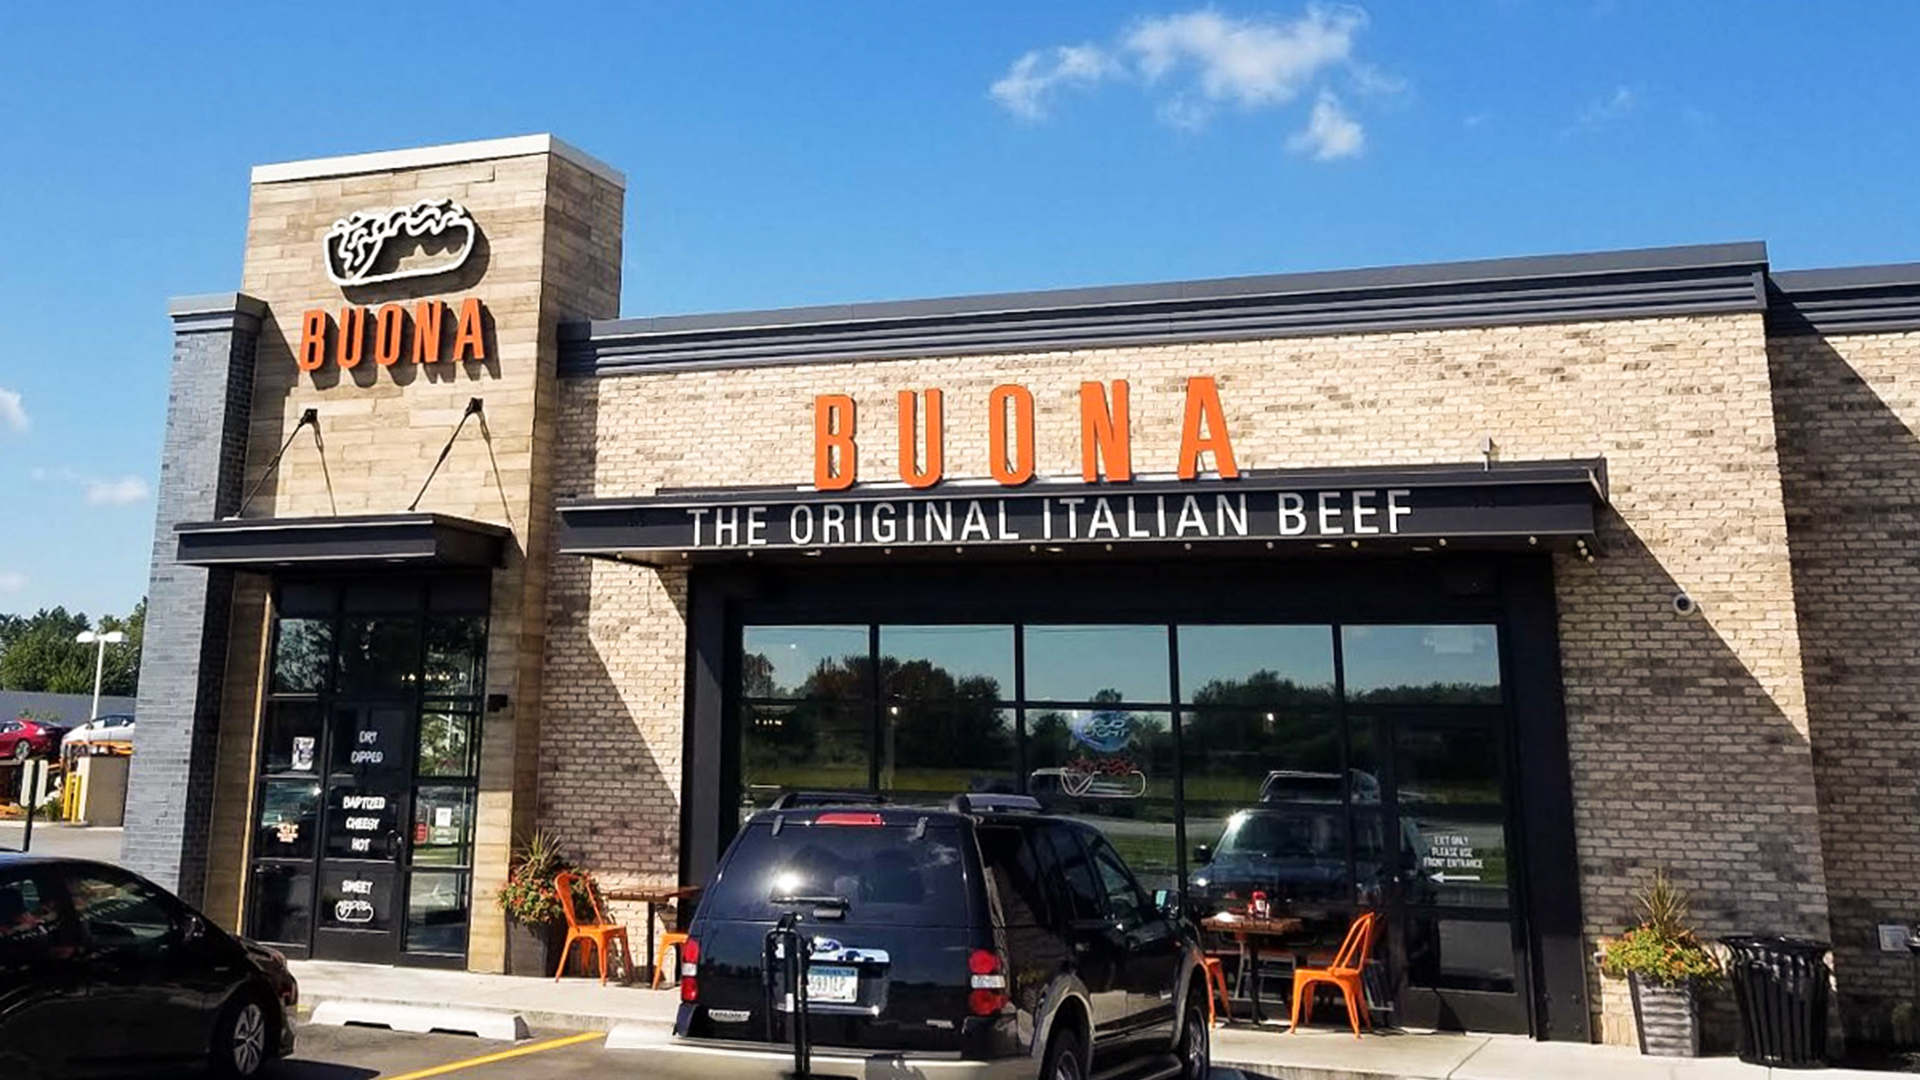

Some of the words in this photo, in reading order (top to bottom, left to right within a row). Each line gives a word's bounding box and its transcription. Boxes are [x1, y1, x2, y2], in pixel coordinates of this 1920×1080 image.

[300, 298, 484, 372] BUONA
[814, 376, 1240, 490] BUONA
[687, 506, 768, 547] THE
[790, 500, 1019, 545] ORIGINAL
[1044, 493, 1248, 540] ITALIAN
[1278, 489, 1411, 536] BEEF
[351, 750, 384, 764] DIPPED
[342, 796, 386, 810] BAPTIZED
[345, 816, 380, 830] CHEESY
[351, 837, 371, 852] HOT
[341, 880, 374, 895] SWEET
